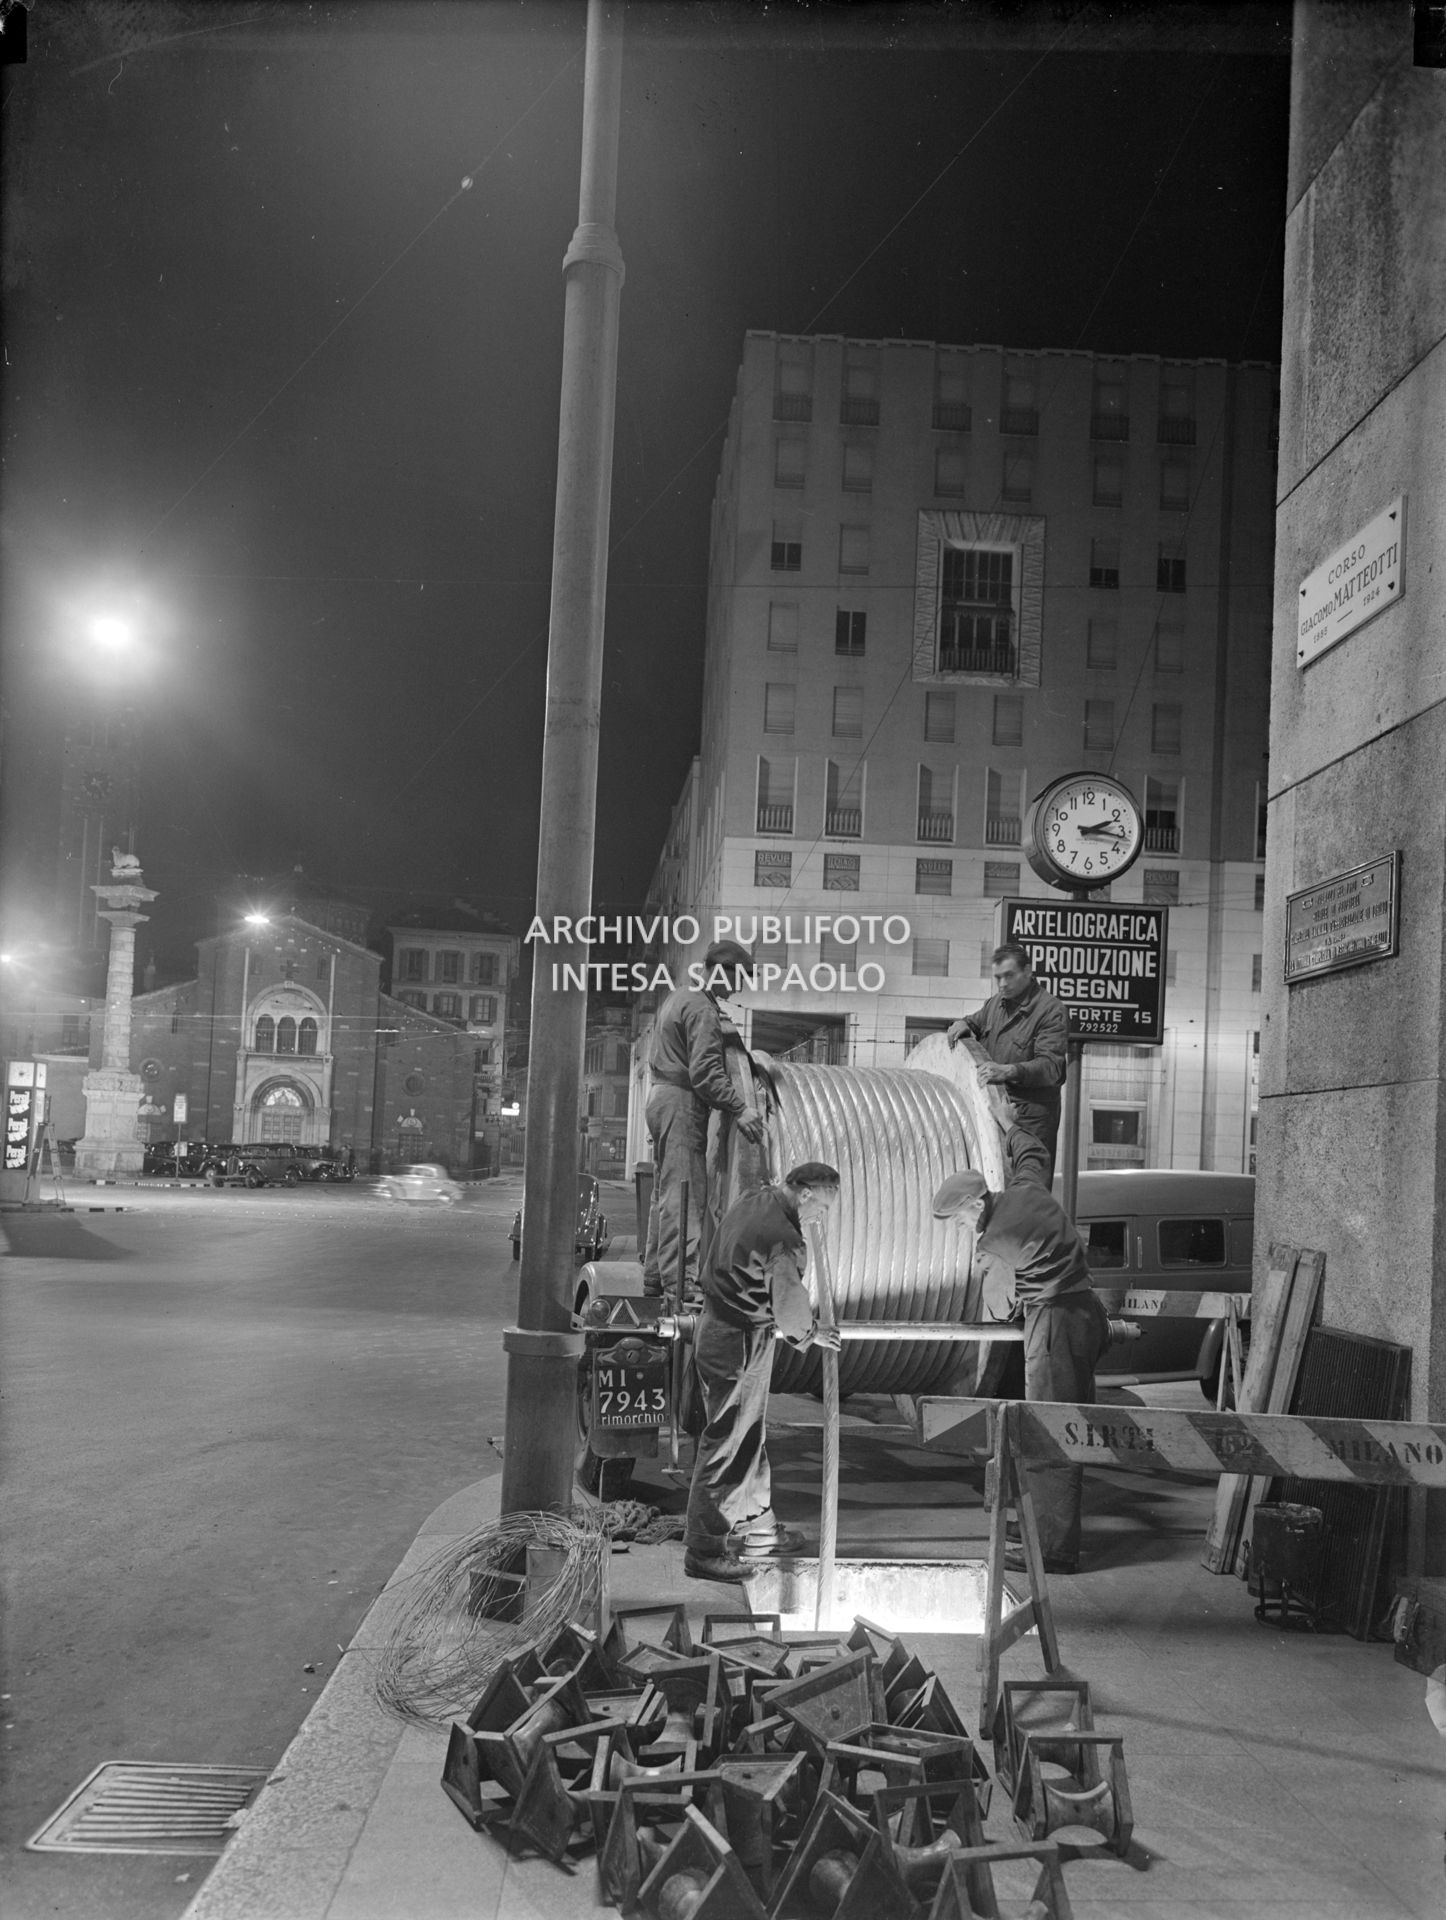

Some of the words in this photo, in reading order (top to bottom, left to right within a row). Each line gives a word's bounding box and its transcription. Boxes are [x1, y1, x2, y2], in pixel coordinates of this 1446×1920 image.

[1328, 544, 1366, 584] CORSO
[1300, 600, 1333, 636] GIACOMO
[1332, 542, 1398, 612] MATTEOTTI
[1362, 586, 1381, 607] 1924
[1070, 796, 1078, 810] 11
[1082, 791, 1095, 805] 12
[1102, 798, 1106, 811] 1
[1055, 808, 1068, 821] 10
[1112, 809, 1121, 822] 2
[1052, 823, 1061, 837] 9
[1117, 825, 1126, 838] 3
[1056, 839, 1066, 853] 8
[1111, 841, 1121, 854] 4
[758, 853, 790, 863] REVUE
[1070, 850, 1079, 865] 7
[1084, 856, 1093, 870] 6
[1099, 851, 1108, 865] 5
[1012, 909, 1158, 941] ARTELIOGRAFICA
[1019, 944, 1157, 978] PRODUZIONE
[1069, 1007, 1122, 1022] FORTE
[1133, 1011, 1152, 1024] 15
[1079, 1022, 1119, 1033] 792522
[598, 1369, 626, 1387] MI
[599, 1388, 666, 1414] 7943
[602, 1412, 665, 1425] rimorchio
[1329, 1440, 1444, 1465] MILANO
